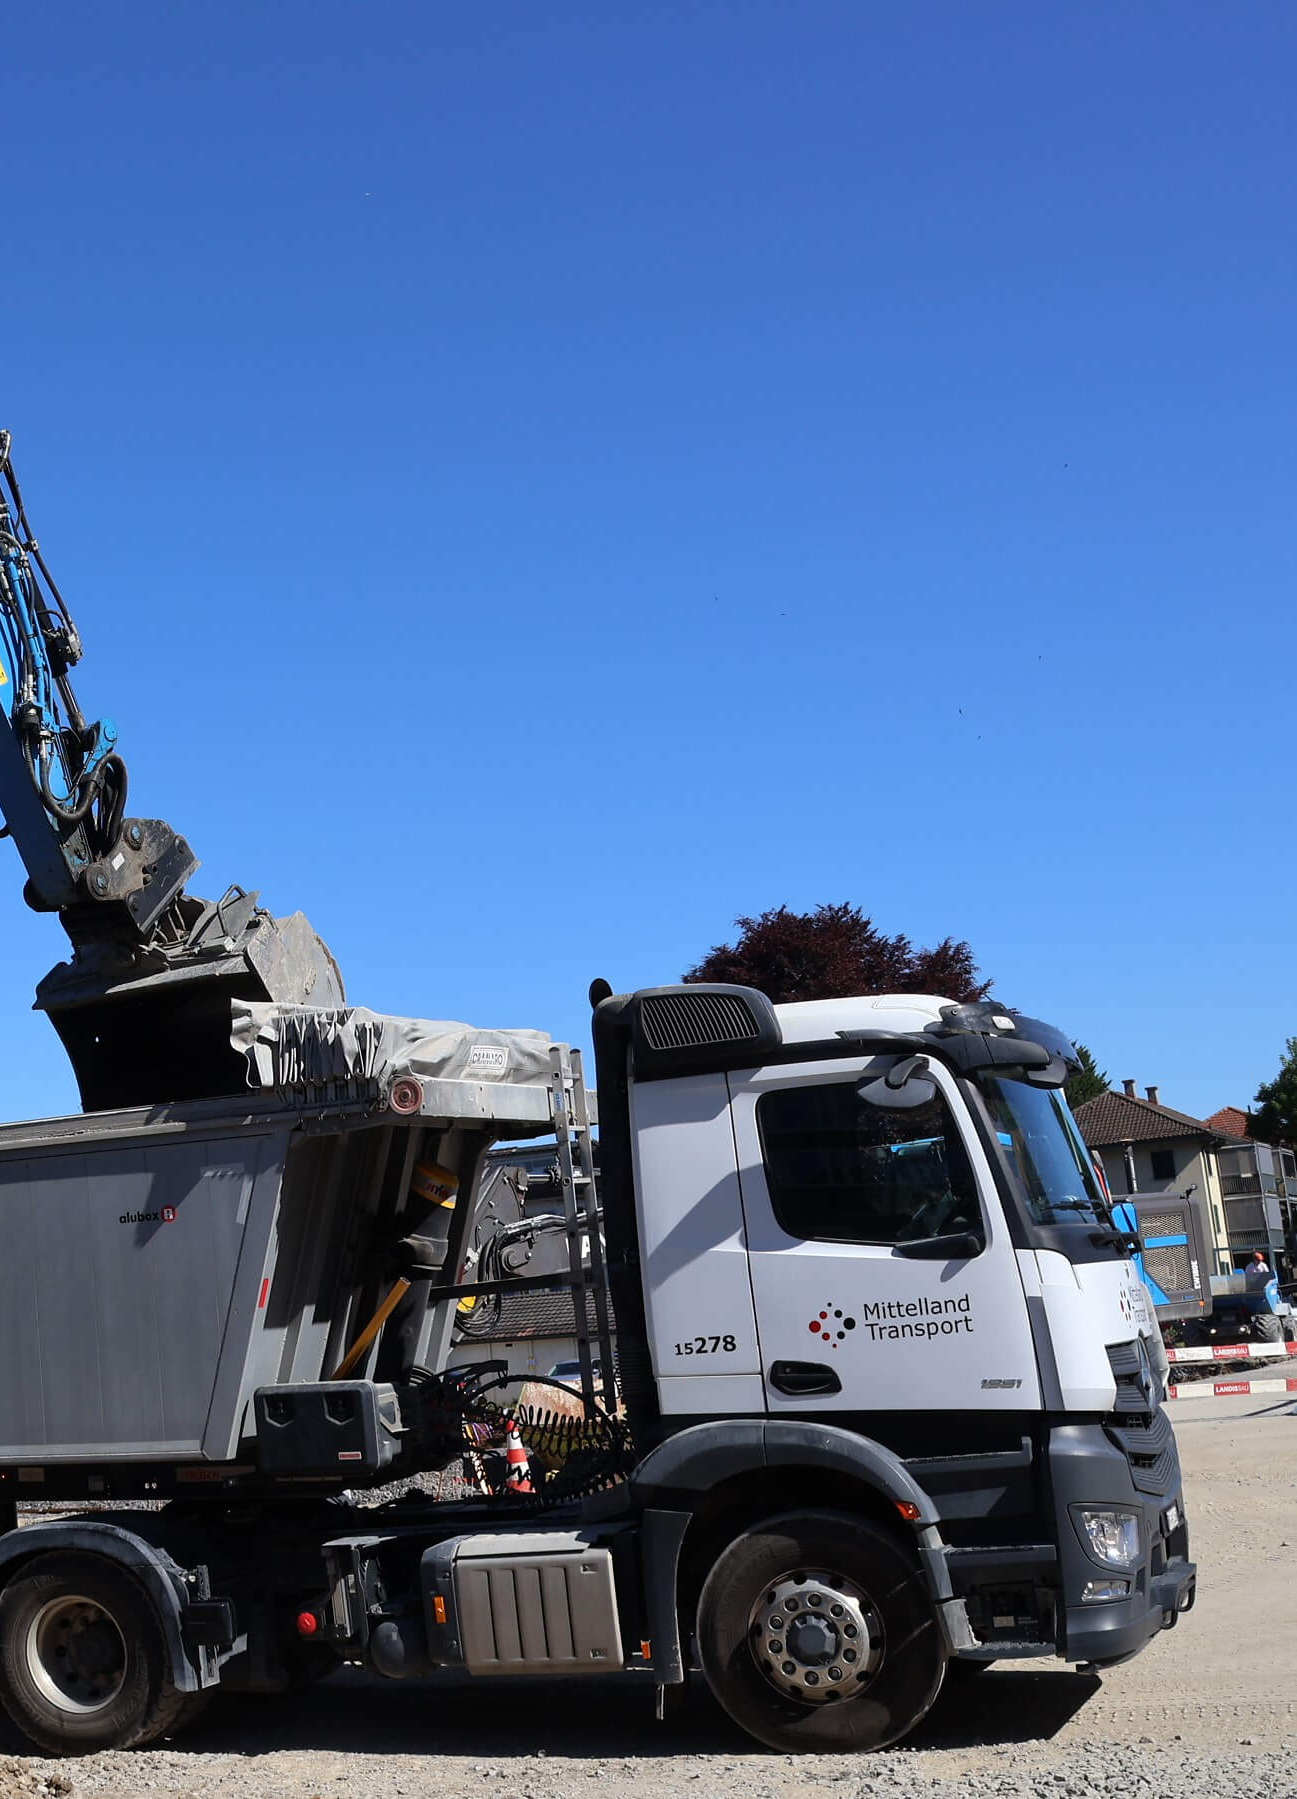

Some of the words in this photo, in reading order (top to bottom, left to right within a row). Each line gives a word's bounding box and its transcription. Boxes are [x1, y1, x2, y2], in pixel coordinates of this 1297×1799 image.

[119, 1211, 159, 1224] alubox
[863, 1293, 971, 1321] Mittelland
[864, 1315, 974, 1341] Transport
[1215, 1383, 1249, 1393] LANDISBAU
